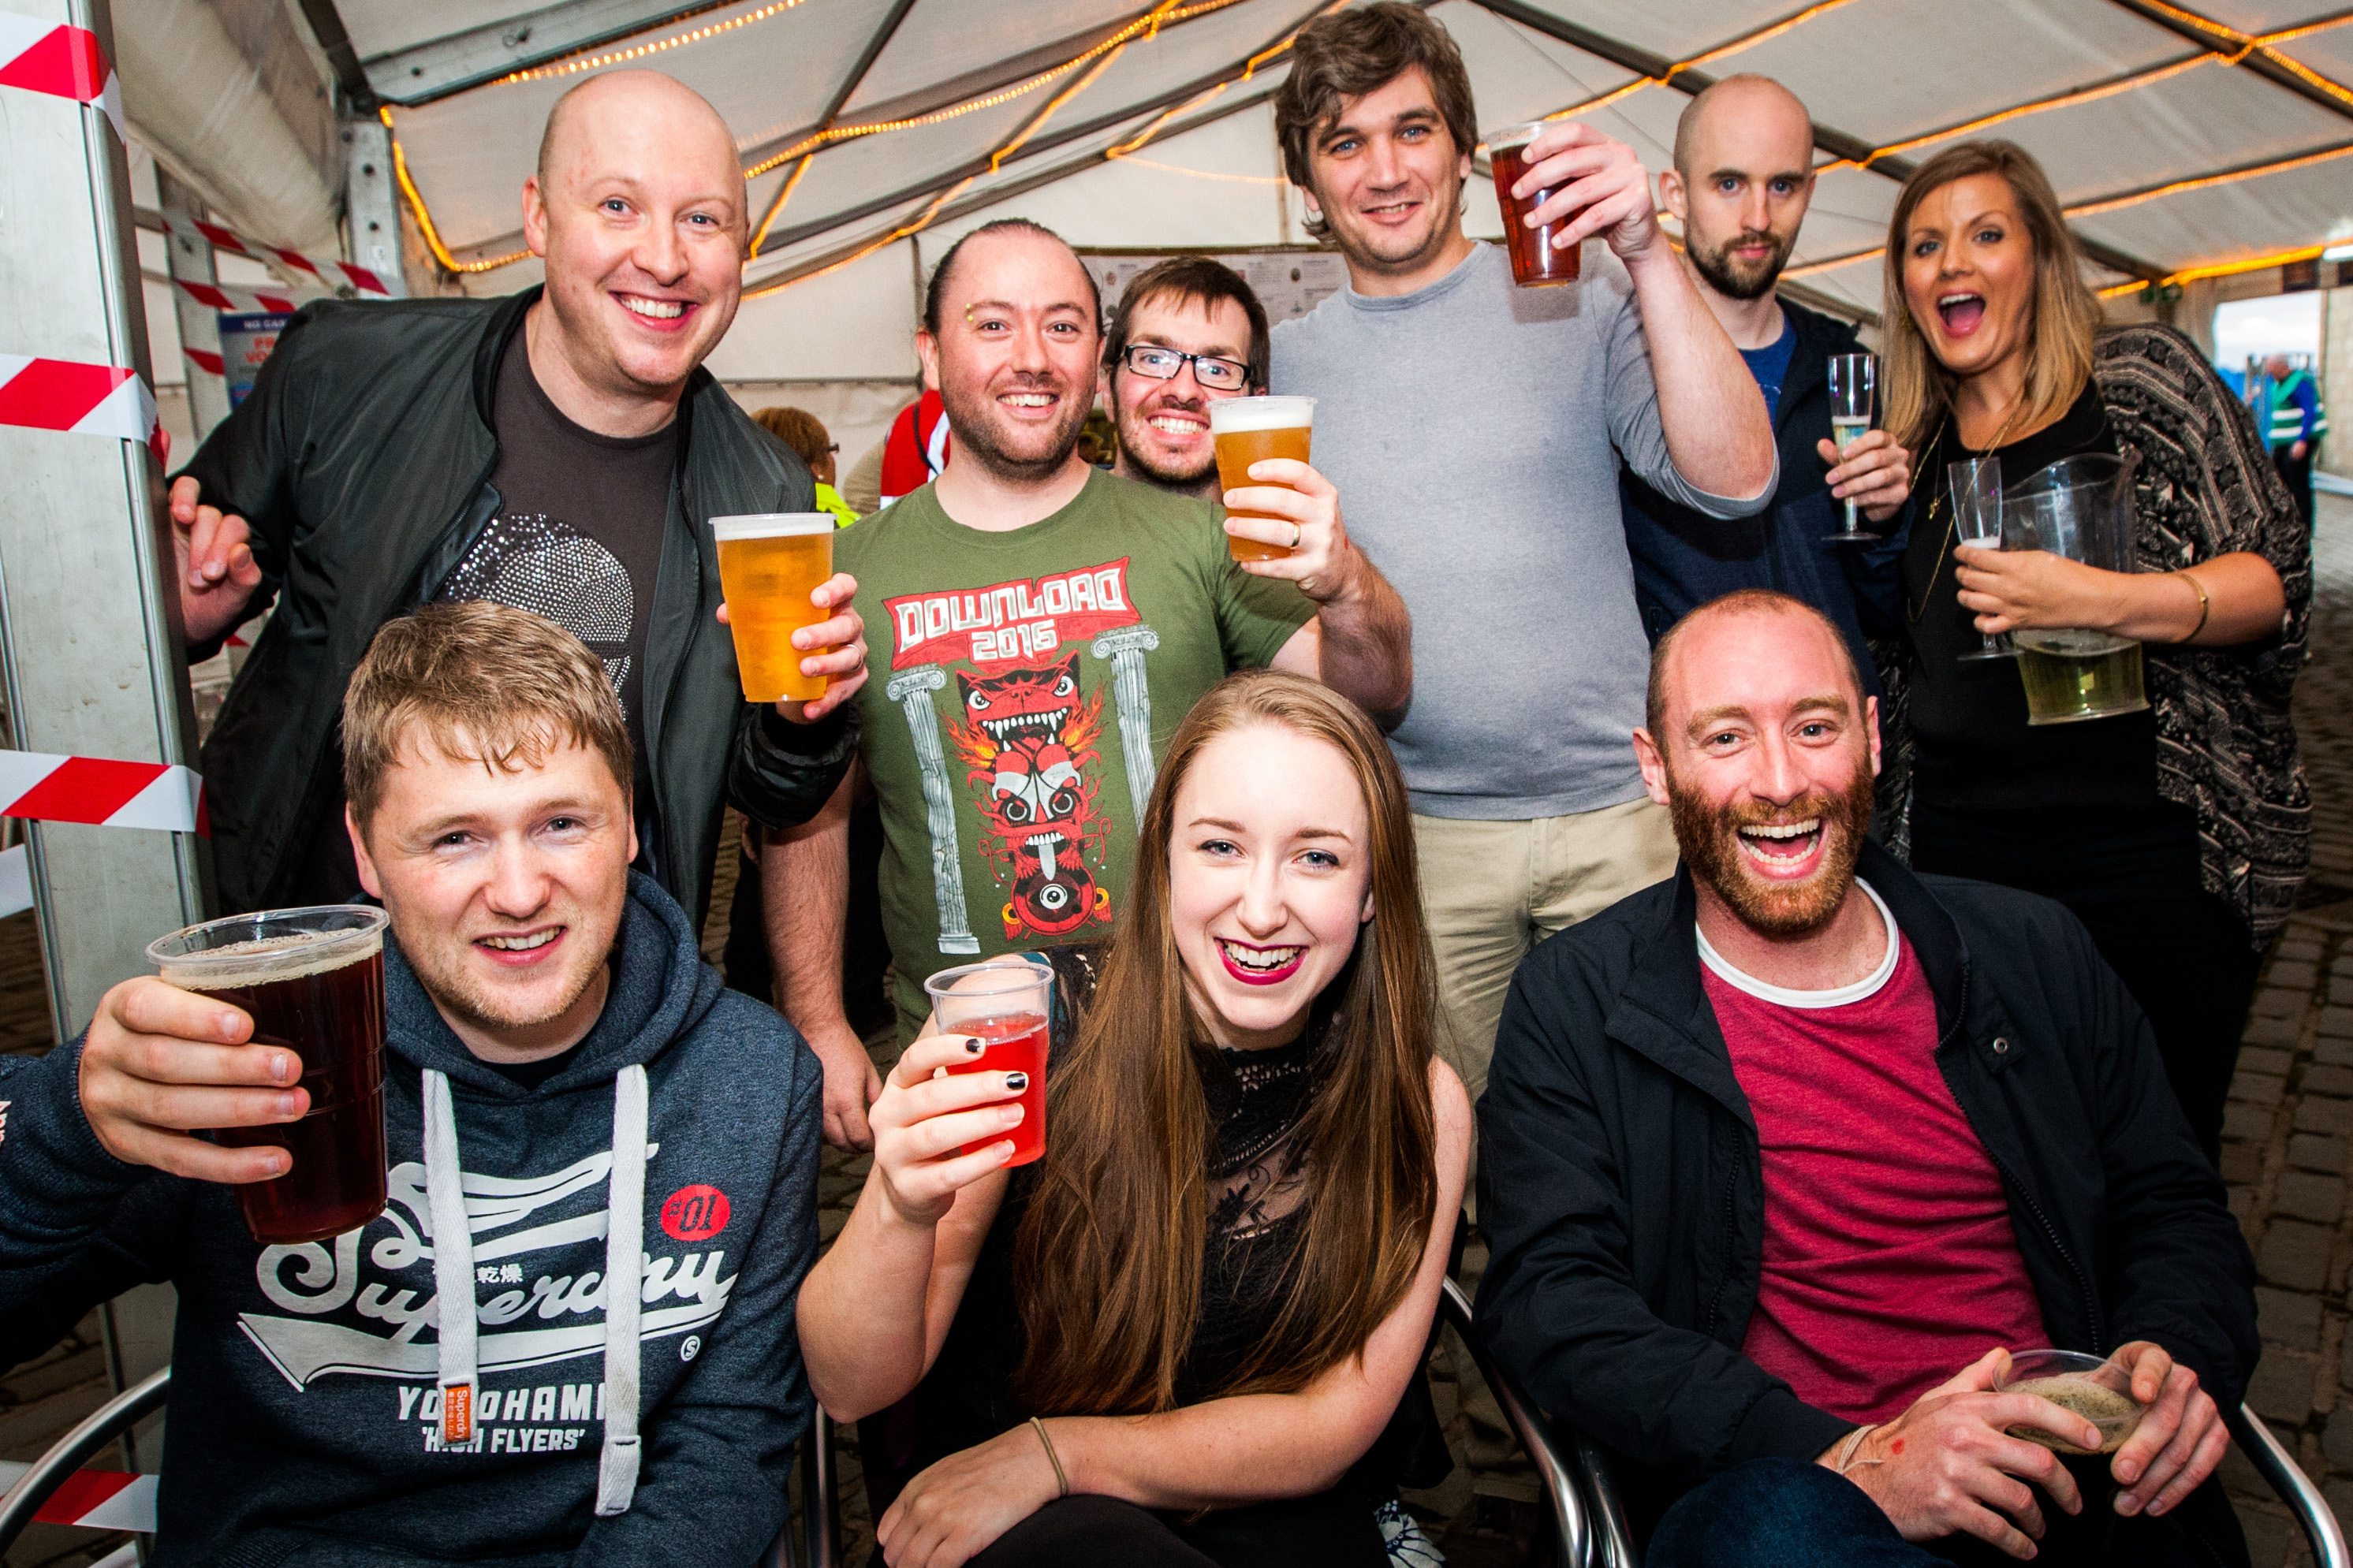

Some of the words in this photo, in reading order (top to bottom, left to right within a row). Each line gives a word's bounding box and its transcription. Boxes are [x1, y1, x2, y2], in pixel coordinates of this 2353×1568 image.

[895, 568, 1128, 653] DOWNLOAD
[971, 619, 1057, 661] 2016
[398, 1383, 606, 1421] YOOHAM
[455, 1390, 468, 1439] Superdry
